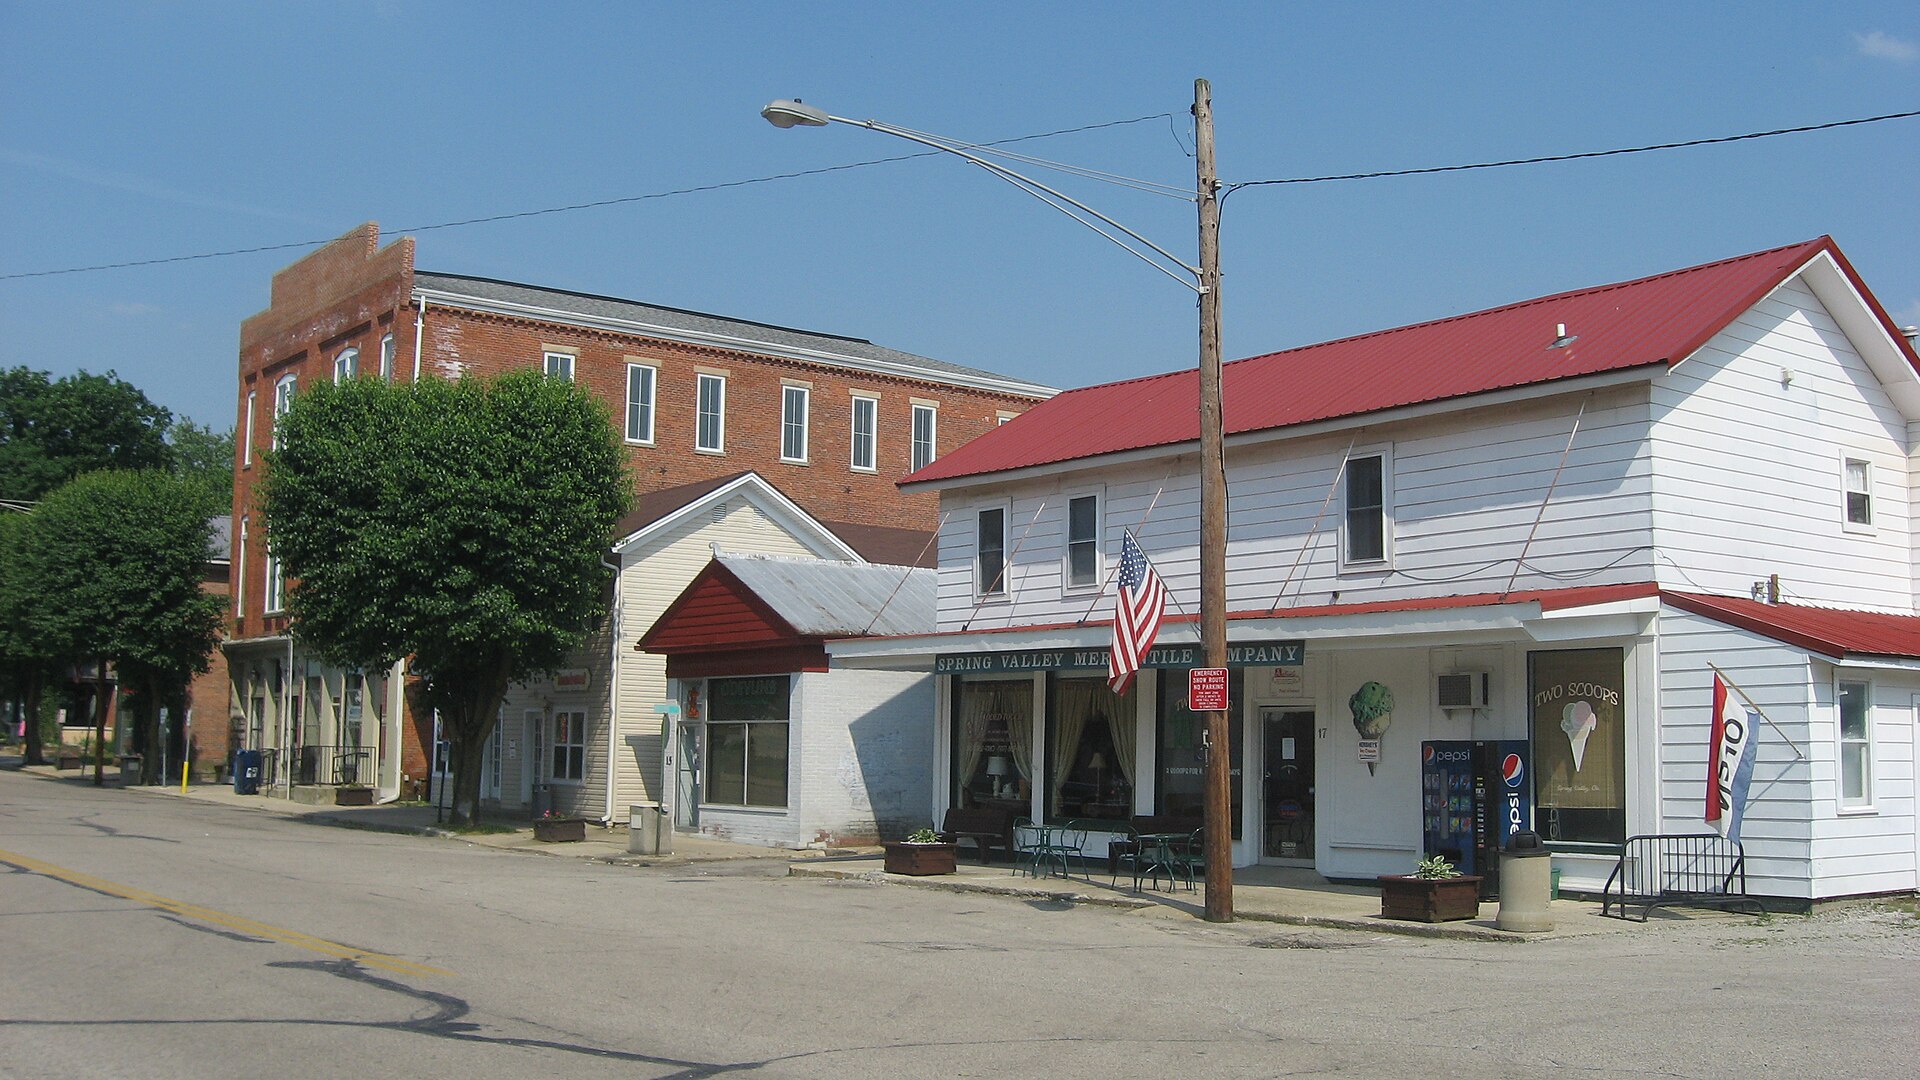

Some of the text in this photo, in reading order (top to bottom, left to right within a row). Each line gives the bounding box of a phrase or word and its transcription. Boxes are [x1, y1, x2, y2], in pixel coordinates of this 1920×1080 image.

[938, 646, 1298, 671] SPRING VALLEY MERTILE MPANY
[1535, 682, 1619, 707] TWO SCOOPS
[1318, 727, 1328, 739] 17
[1436, 749, 1471, 762] pepsi
[1507, 792, 1522, 835] epsi
